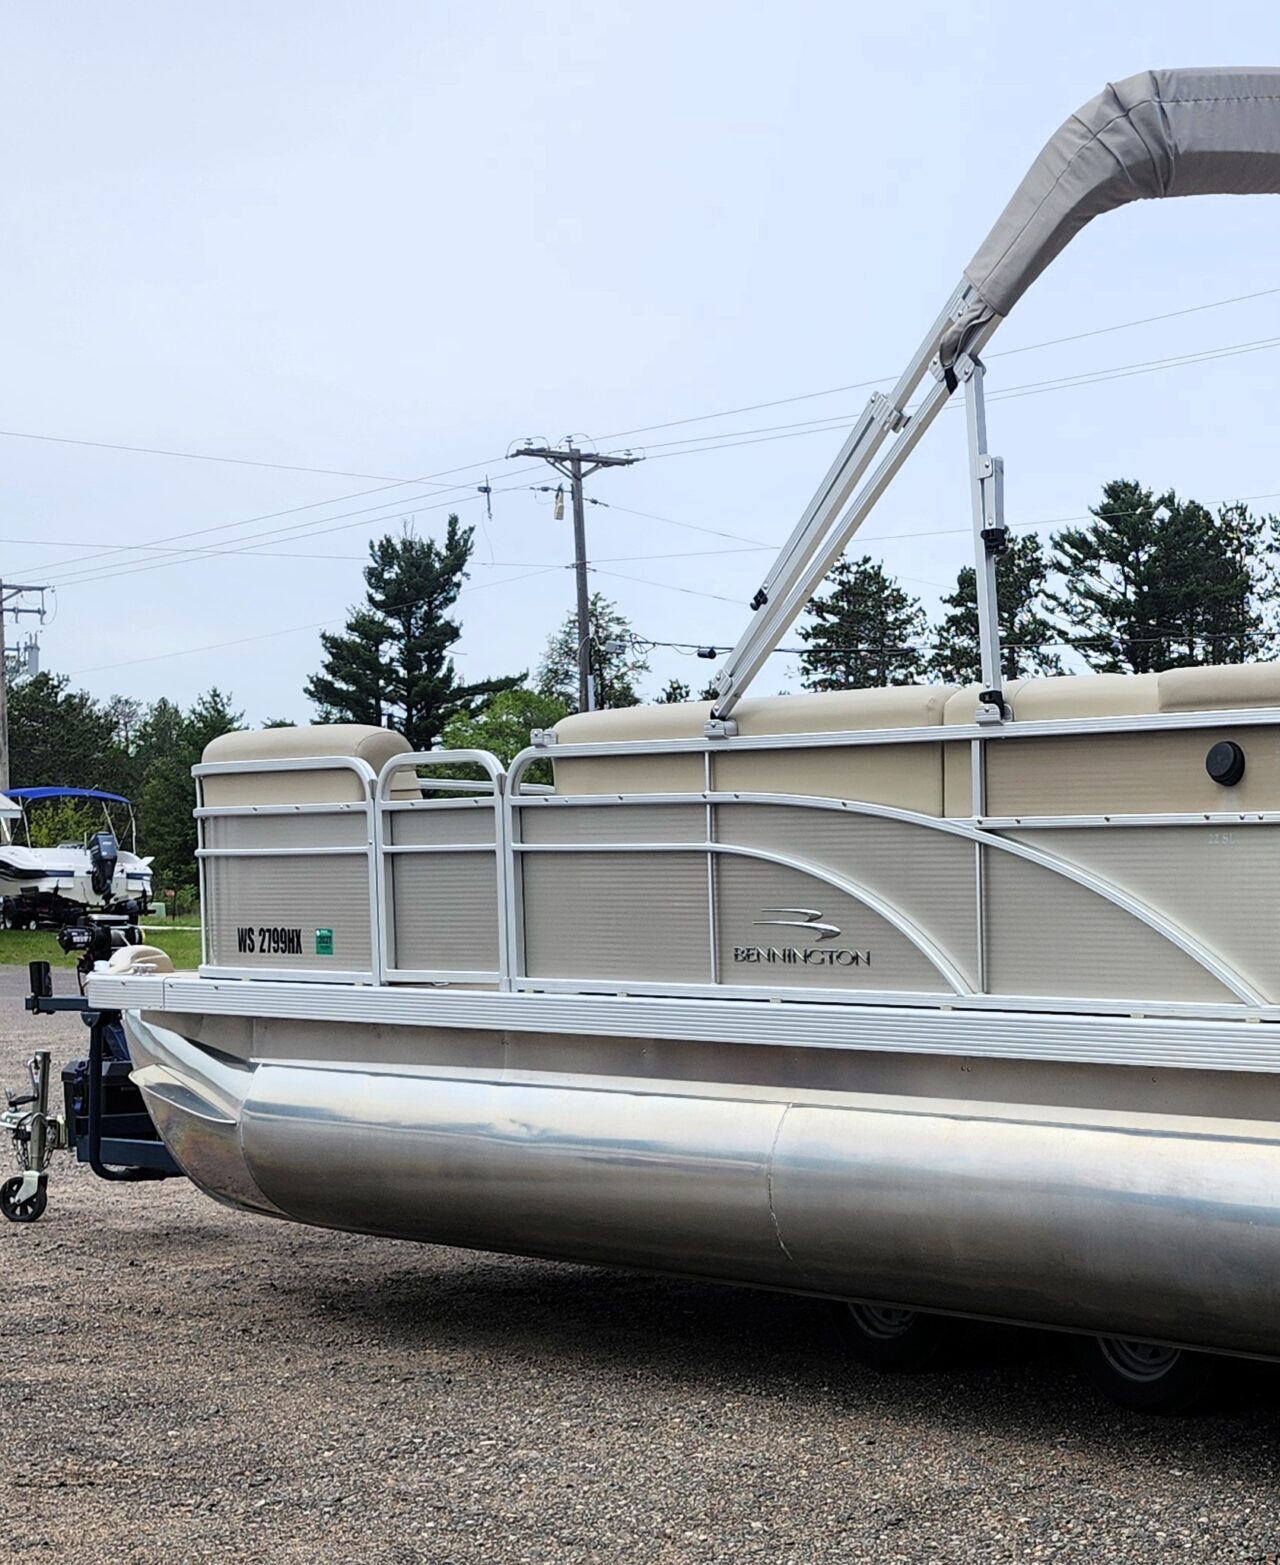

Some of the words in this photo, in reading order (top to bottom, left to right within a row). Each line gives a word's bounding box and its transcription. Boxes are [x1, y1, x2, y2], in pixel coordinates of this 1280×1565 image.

[237, 927, 256, 954] WS
[258, 927, 303, 955] 2799HX
[733, 946, 872, 967] BENNINGTON
